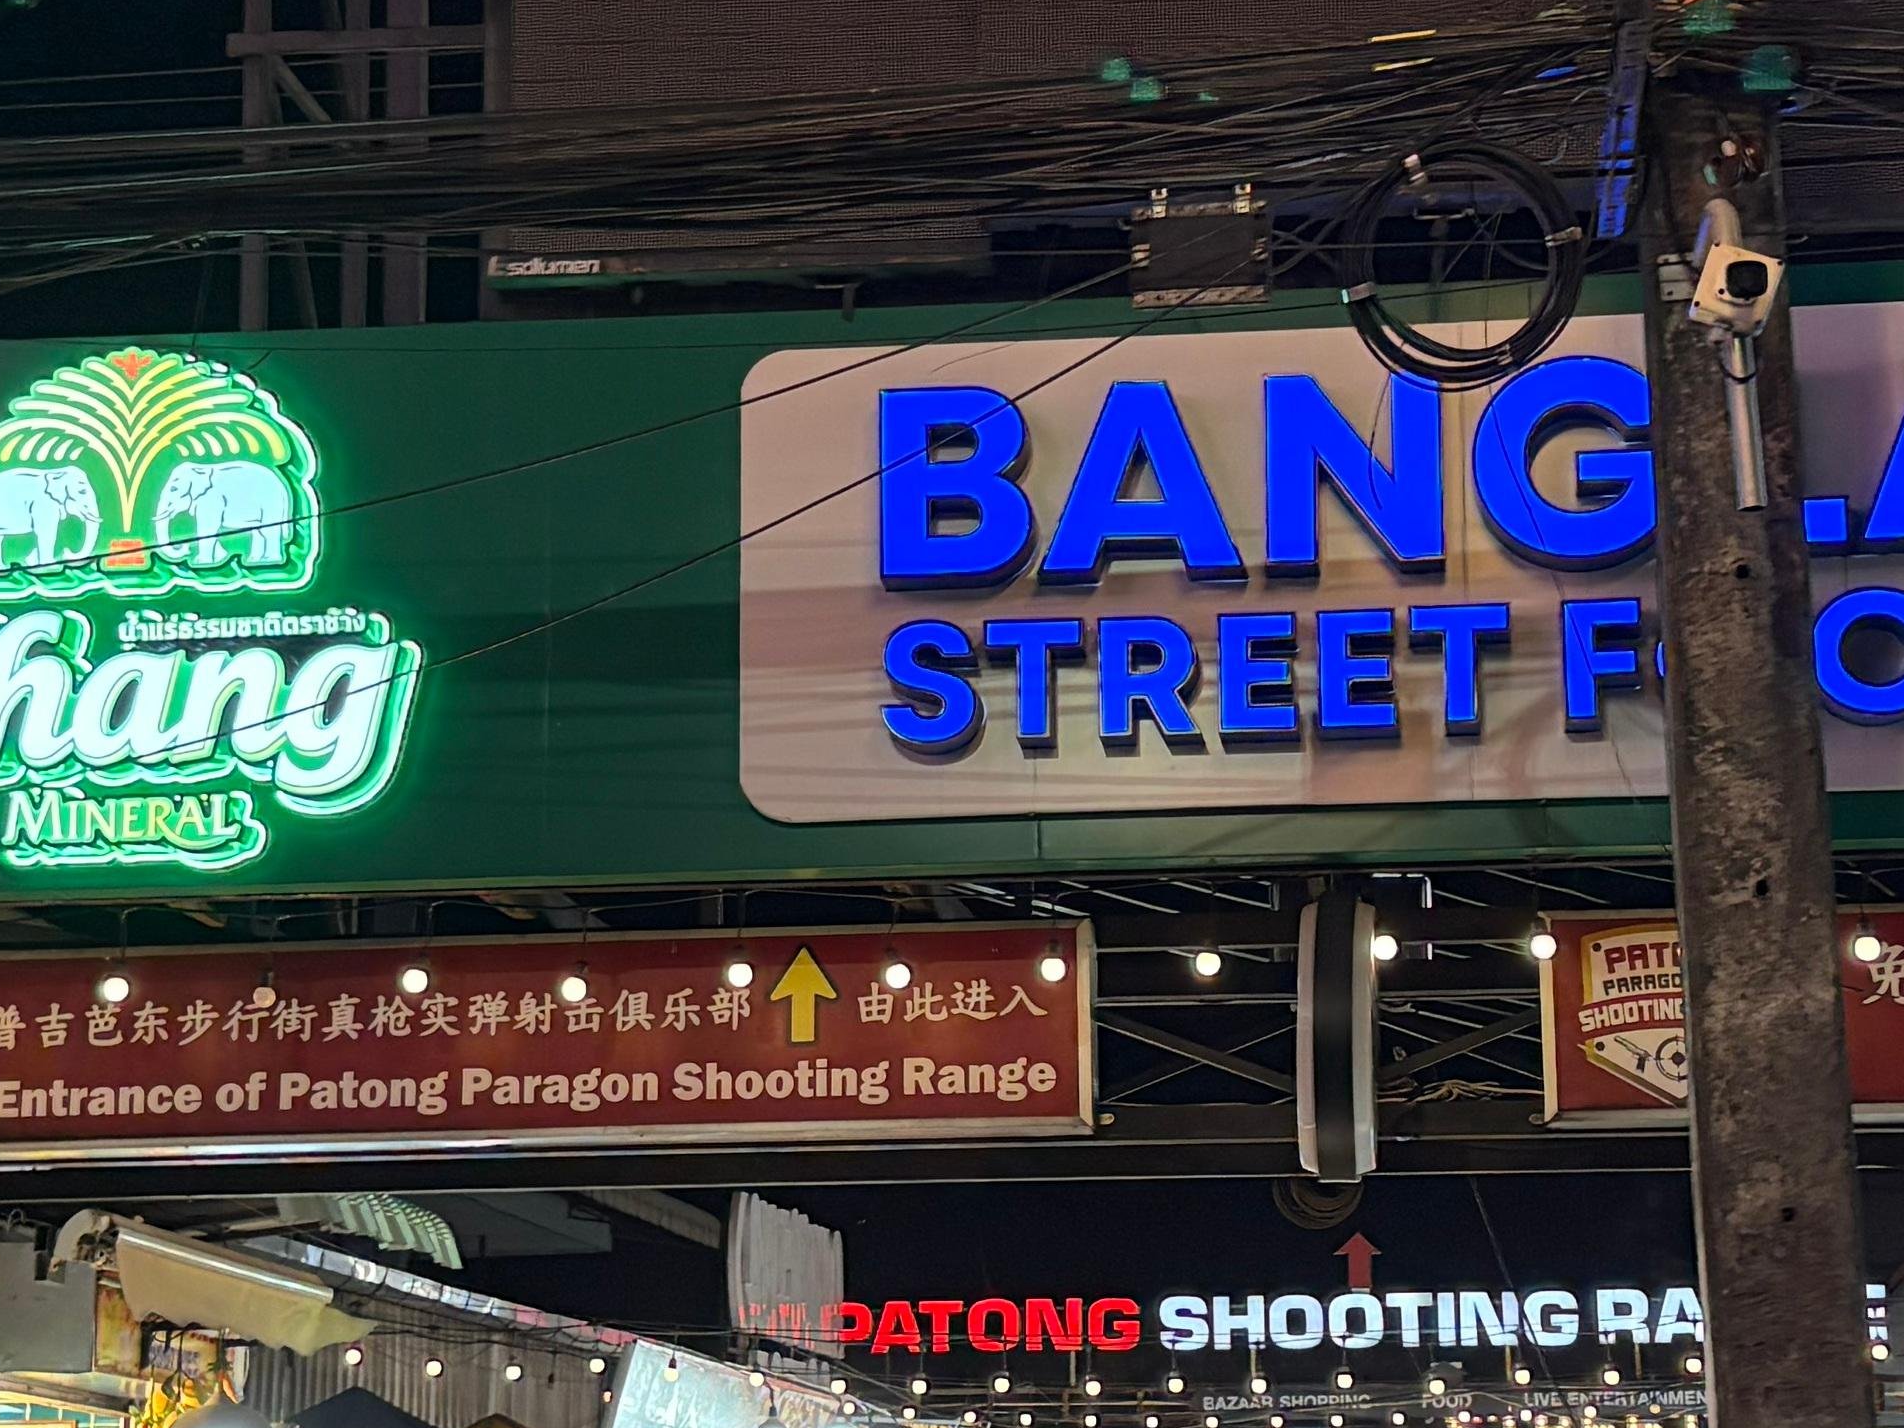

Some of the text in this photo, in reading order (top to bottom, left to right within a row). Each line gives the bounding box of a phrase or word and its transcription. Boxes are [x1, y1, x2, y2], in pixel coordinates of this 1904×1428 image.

[881, 600, 1512, 756] STREET
[856, 978, 1049, 1026] 由此进入
[1602, 973, 1684, 997] PARAGO
[215, 1071, 268, 1111] of
[279, 1068, 448, 1116] Patong
[461, 1066, 659, 1113] Paragon
[672, 1056, 891, 1106] Shooting
[903, 1055, 1058, 1104] Range
[825, 1287, 1581, 1355] PATONG SHOOTING
[1202, 1393, 1373, 1412] BAZAAR SHOPPING
[1422, 1391, 1473, 1409] FOOD
[1524, 1388, 1708, 1408] LIVE ENTERTAINMEN
